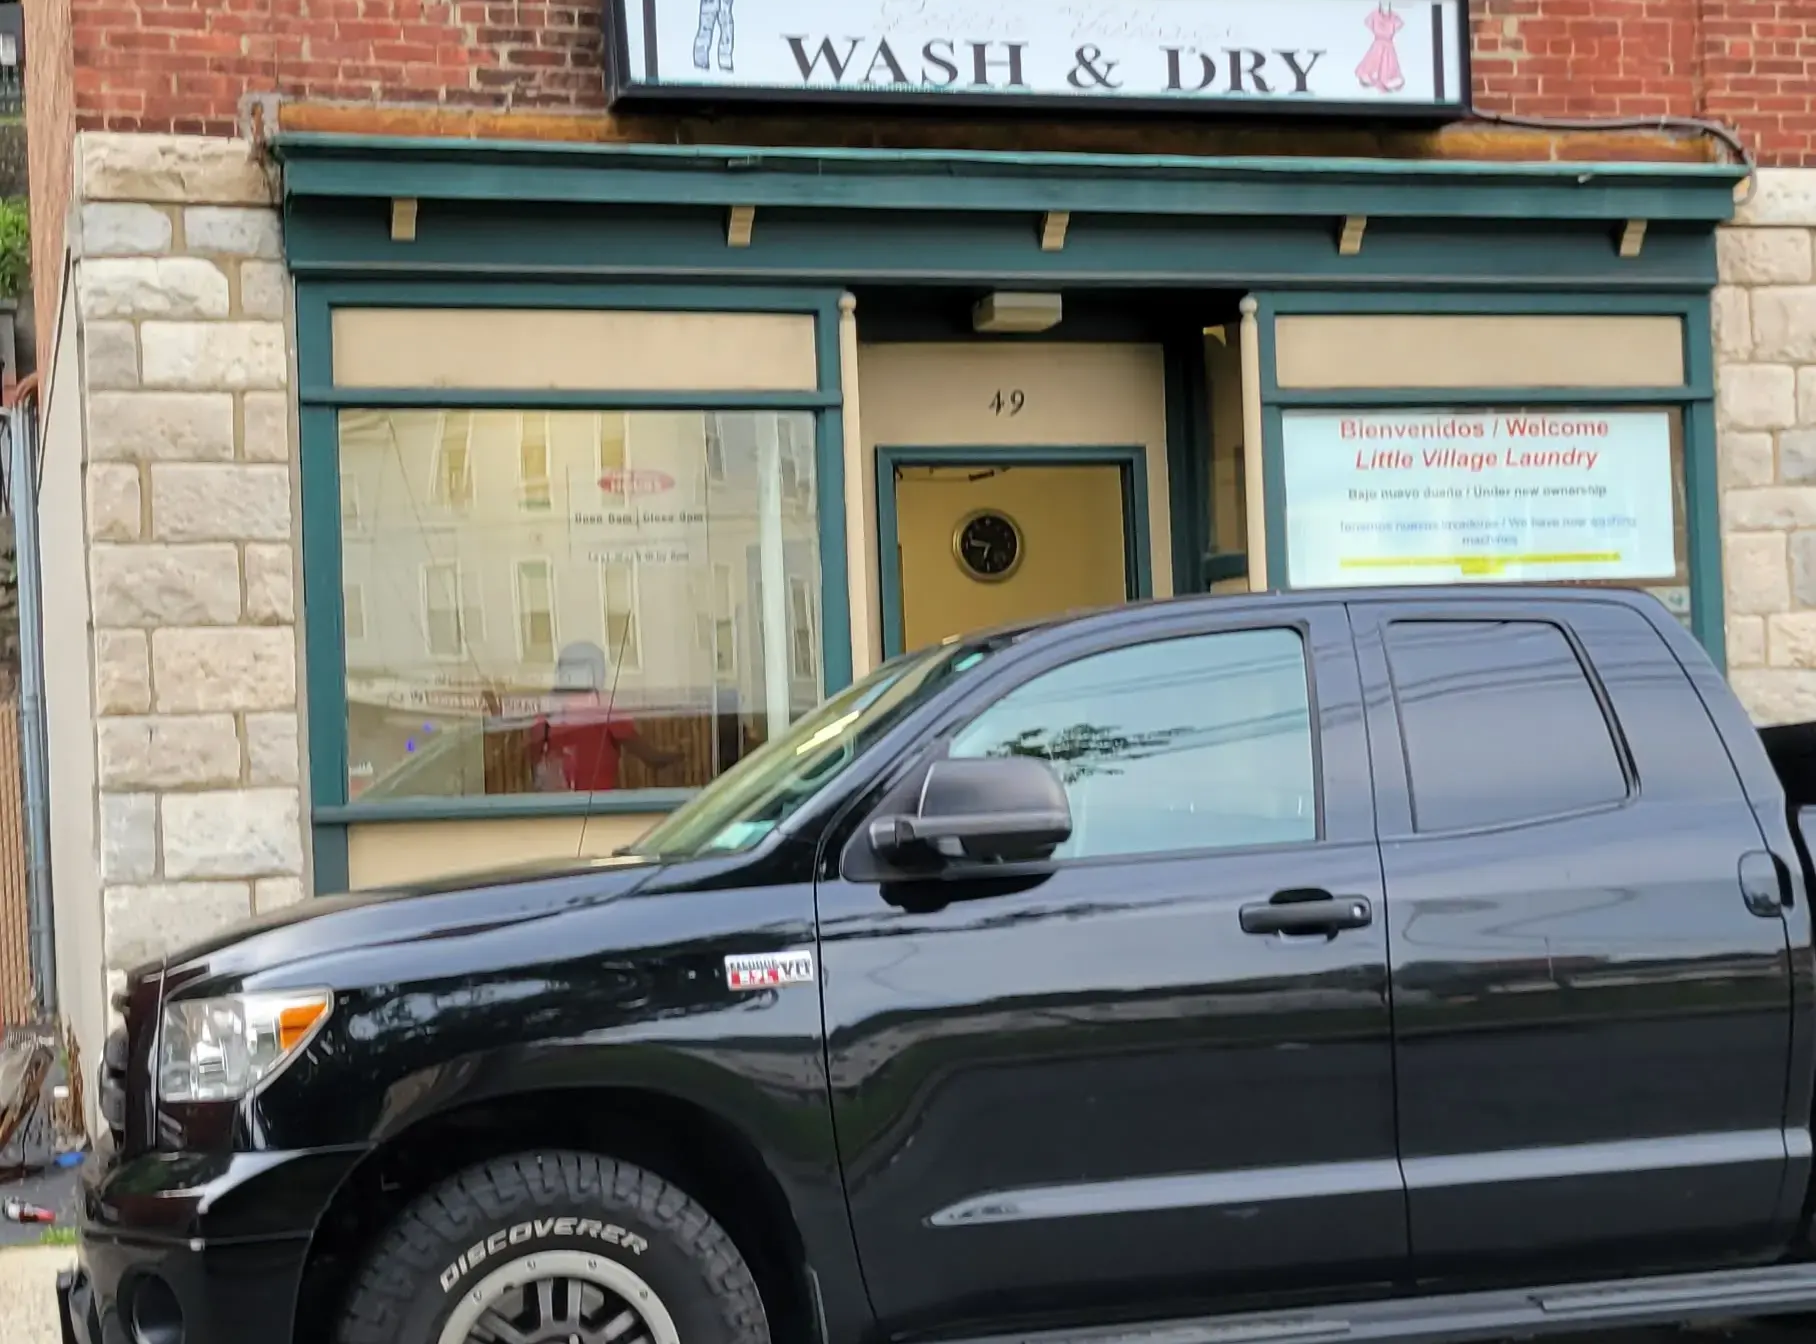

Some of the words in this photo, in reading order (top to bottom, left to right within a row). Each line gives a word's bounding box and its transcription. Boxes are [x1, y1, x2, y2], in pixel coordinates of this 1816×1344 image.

[781, 34, 1033, 90] WASH
[1067, 43, 1124, 91] &
[1160, 46, 1327, 95] DRY
[989, 389, 1025, 417] 49
[1340, 417, 1484, 440] Bienvenidos
[1506, 416, 1609, 438] Welcome
[1356, 448, 1415, 470] Little
[1422, 447, 1498, 473] Village
[1506, 446, 1598, 471] Laundry
[1473, 485, 1510, 499] Under
[1514, 486, 1540, 499] new
[1543, 484, 1607, 499] ownership
[440, 1216, 649, 1293] DISCOVERER
